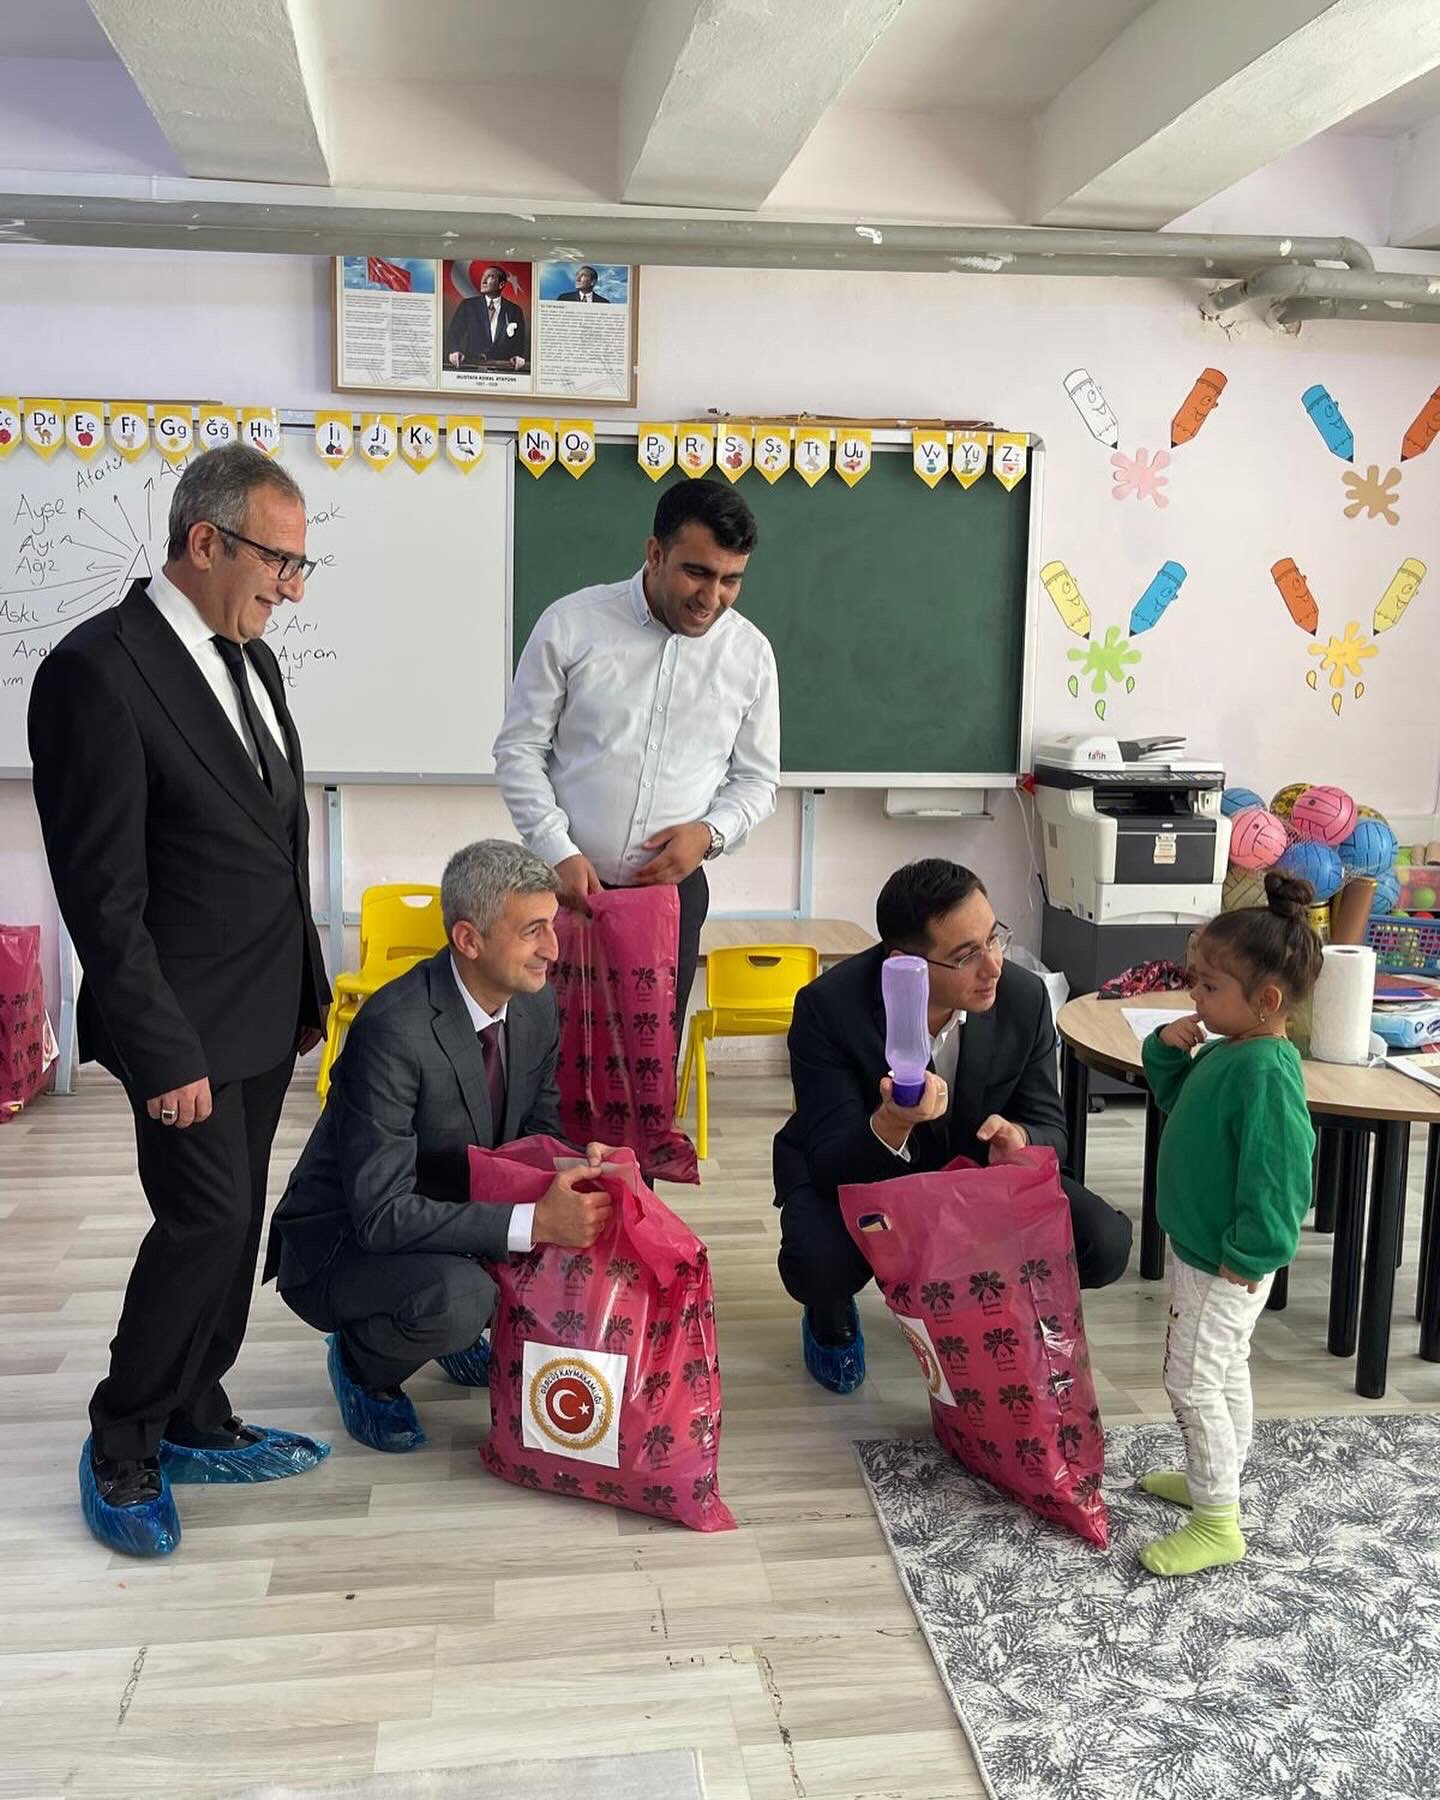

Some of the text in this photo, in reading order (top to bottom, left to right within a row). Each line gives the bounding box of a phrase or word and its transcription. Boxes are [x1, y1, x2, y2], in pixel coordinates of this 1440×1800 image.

[34, 412, 56, 426] Dd
[75, 415, 95, 432] Ee
[121, 416, 136, 433] Ff
[160, 418, 187, 438] Gg
[206, 418, 229, 439] Ğğ
[250, 421, 273, 438] Hh
[370, 424, 386, 445] Jj
[410, 426, 432, 445] Kk
[456, 428, 473, 444] Ll
[526, 432, 550, 450] Nn
[565, 433, 589, 451] Oo
[646, 436, 666, 458] Pp
[685, 437, 705, 453] Rr
[803, 441, 820, 456] Tt
[844, 442, 864, 458] Uu
[921, 444, 941, 459] Vv
[961, 444, 981, 463] Yy
[1001, 446, 1020, 462] Zz
[278, 645, 337, 669] Ayran
